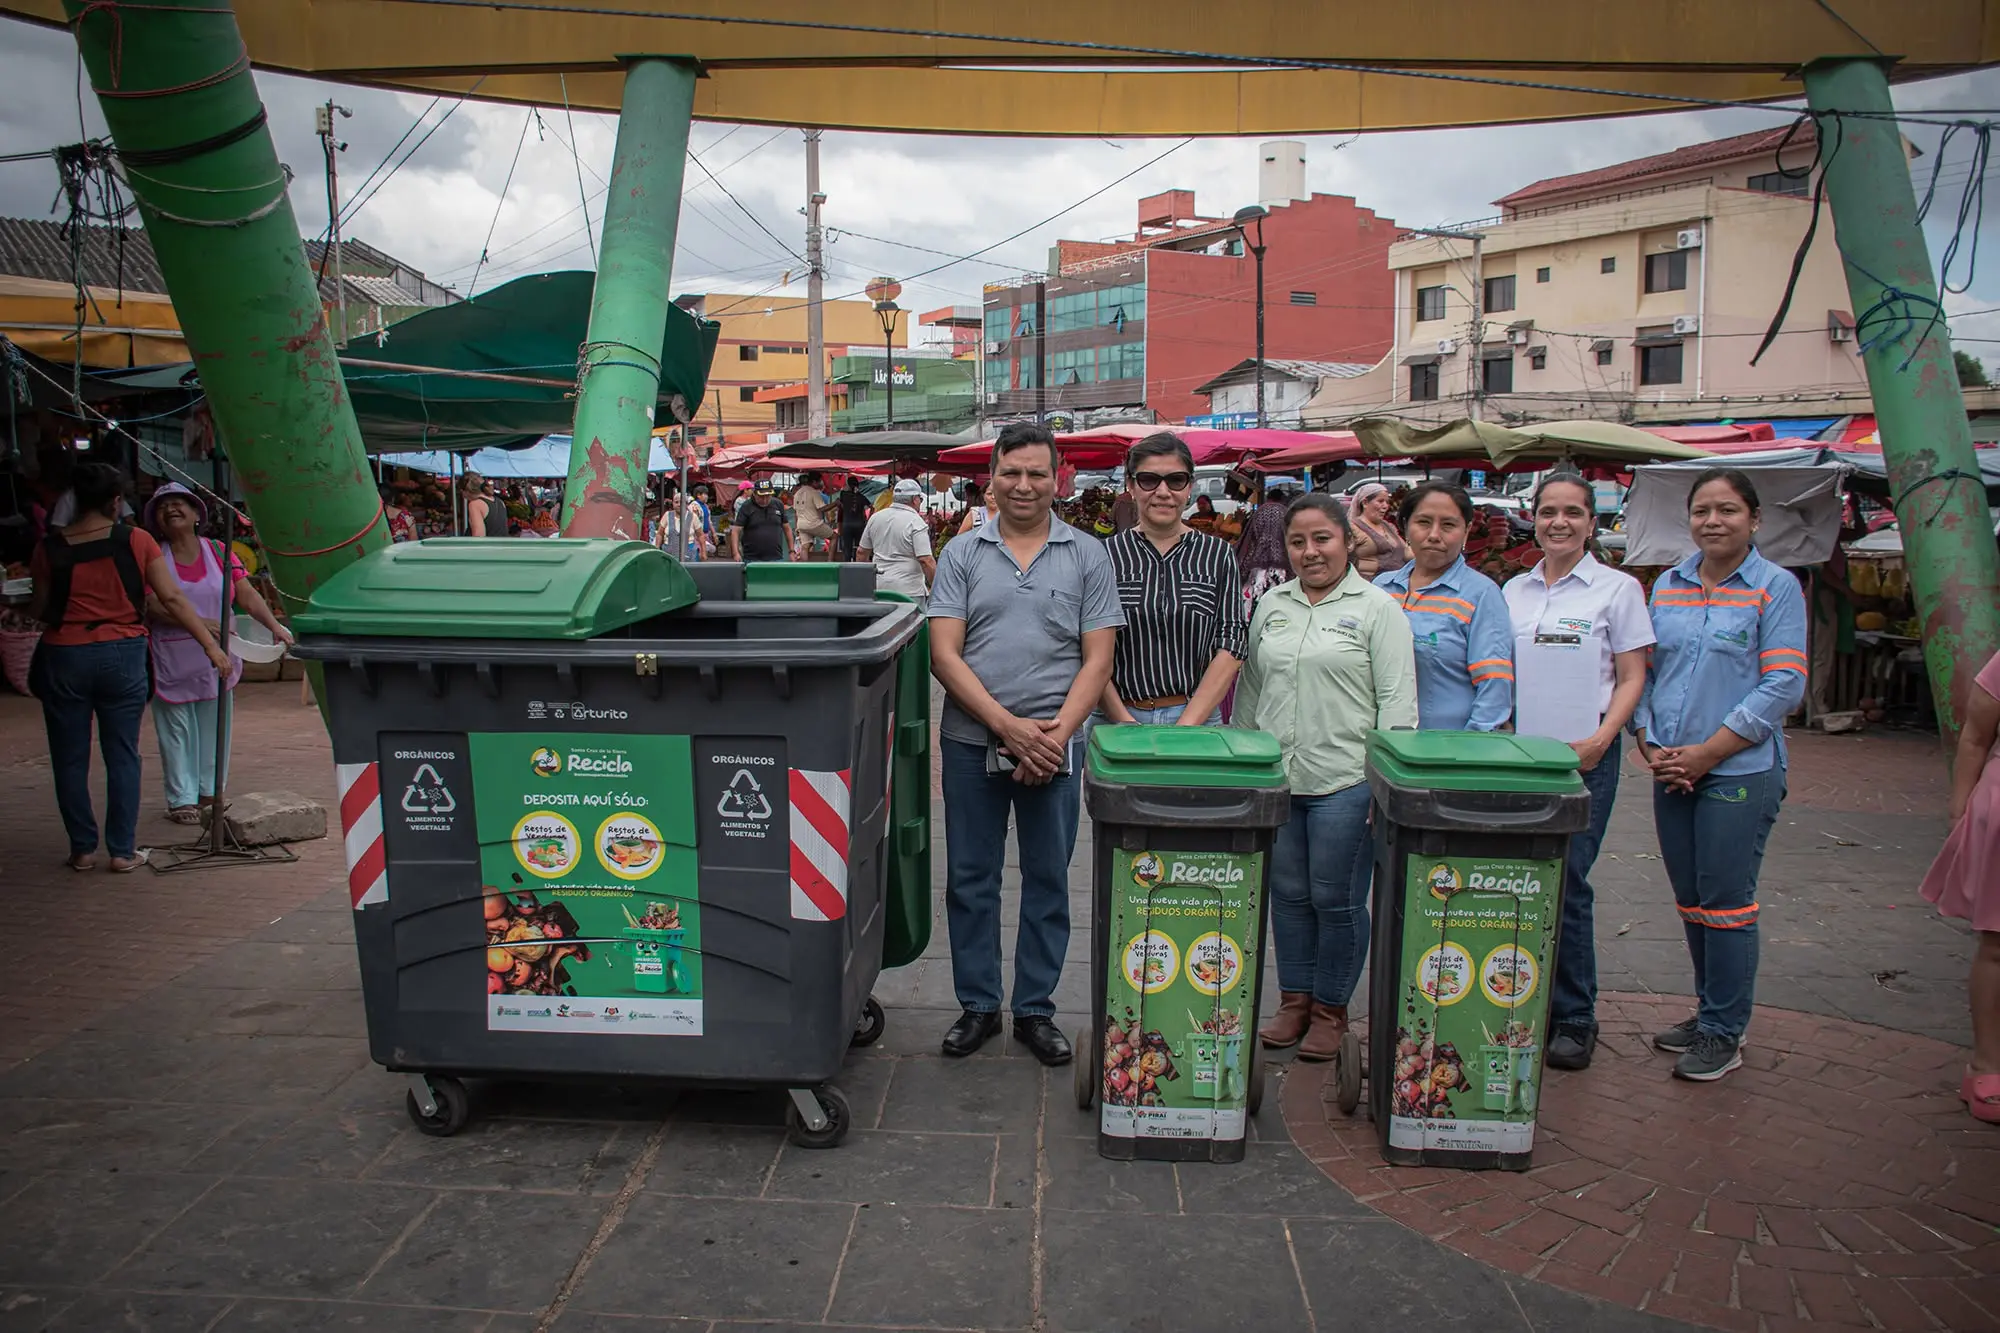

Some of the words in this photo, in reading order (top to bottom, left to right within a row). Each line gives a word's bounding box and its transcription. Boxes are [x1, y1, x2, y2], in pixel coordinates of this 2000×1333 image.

[394, 750, 456, 760] ORGÁNICOS
[567, 754, 633, 773] Recicla
[711, 755, 776, 766] ORGÁNICOS
[524, 794, 580, 805] DEPOSITA
[583, 791, 613, 806] AQUÍ
[614, 792, 649, 807] SÓLO:
[524, 825, 553, 833] Restos
[608, 826, 636, 835] Restos
[720, 822, 761, 830] ALIMENTOS
[725, 830, 766, 838] VEGETALES
[1170, 860, 1244, 883] Recicla
[1468, 871, 1541, 895] Recicla
[551, 889, 588, 897] RESIDUOS
[1129, 895, 1148, 904] Una
[1150, 896, 1178, 905] nueva
[1180, 897, 1200, 905] vida
[1203, 898, 1224, 908] par
[1227, 899, 1242, 908] tus
[1183, 904, 1237, 919] ORGÁNIOS
[1424, 909, 1445, 917] Una
[1446, 909, 1475, 917] nueva
[1477, 908, 1497, 917] vida
[1498, 911, 1521, 919] par
[1523, 911, 1538, 921] tus
[1159, 943, 1169, 951] de
[1135, 950, 1168, 958] Veduras
[1517, 957, 1528, 965] de
[1430, 962, 1463, 970] Veduras
